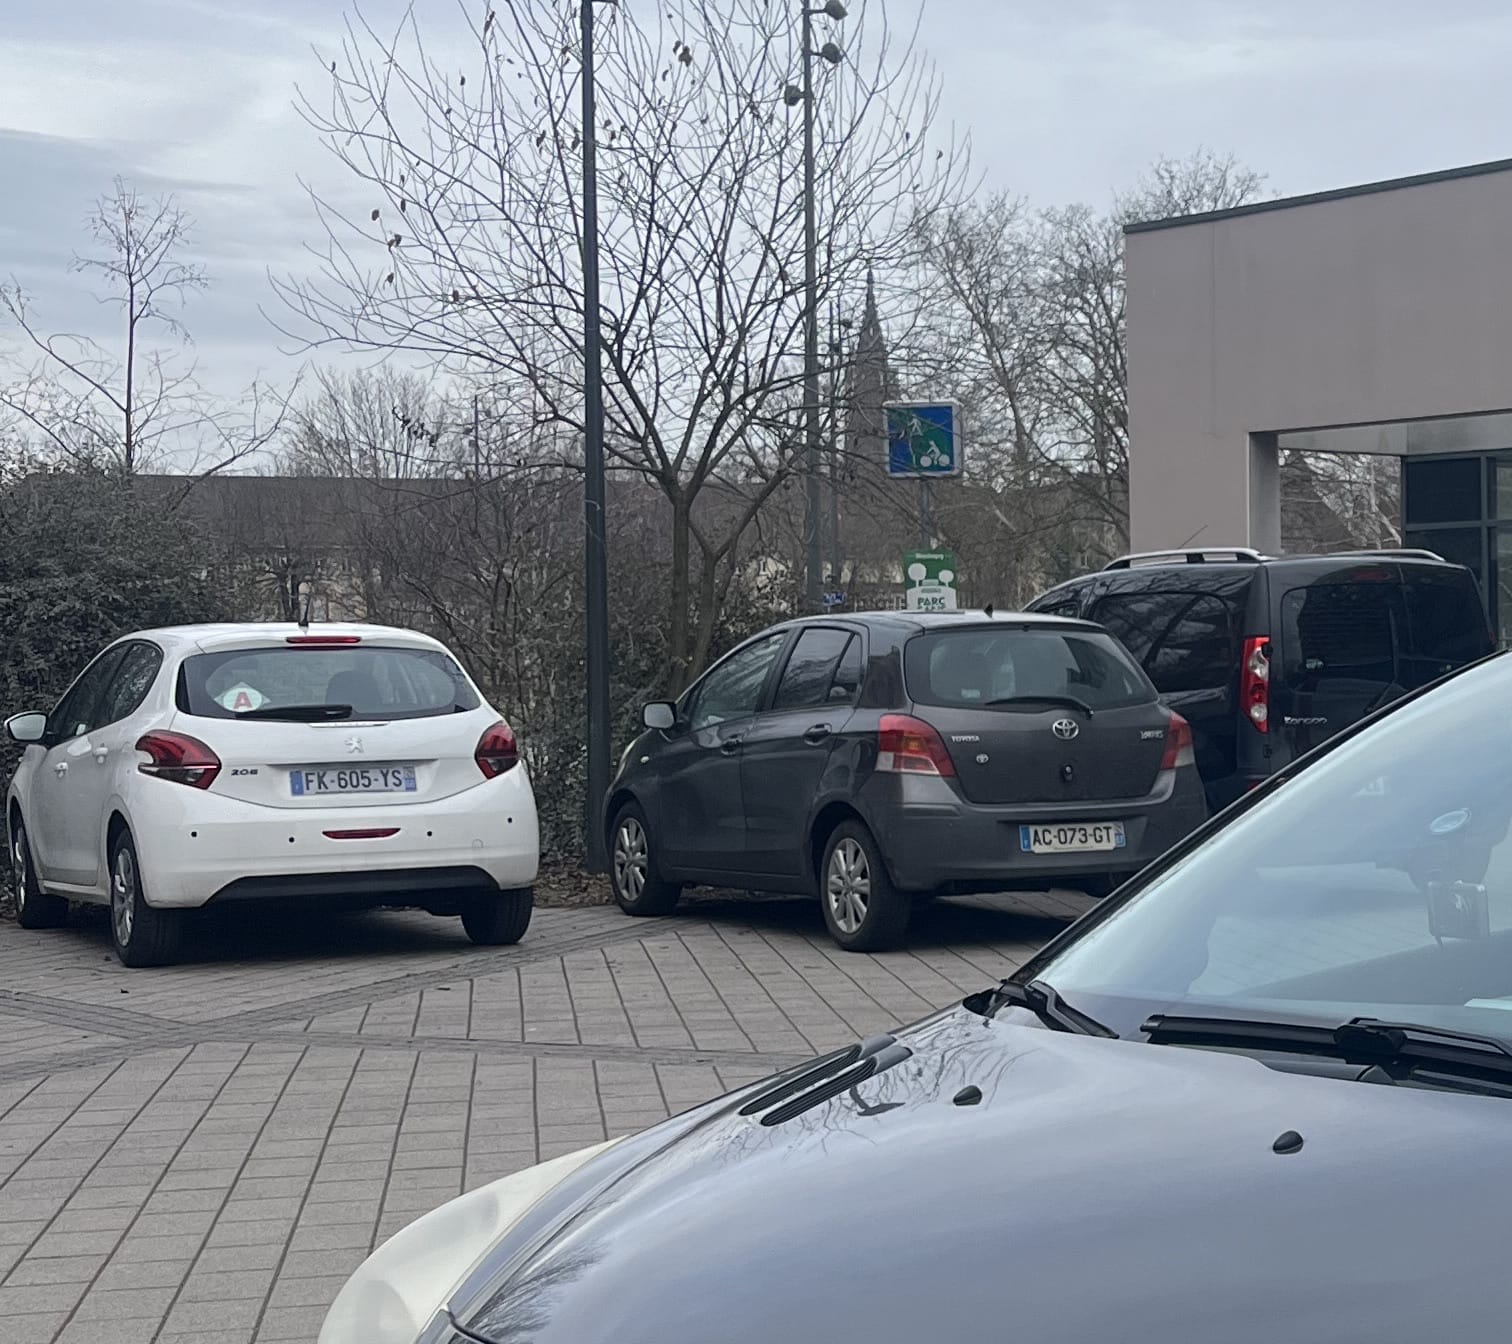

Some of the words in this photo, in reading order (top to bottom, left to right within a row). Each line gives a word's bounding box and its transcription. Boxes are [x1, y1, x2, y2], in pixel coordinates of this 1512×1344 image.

[232, 691, 254, 710] A
[304, 769, 403, 791] FK-605-YS
[1032, 826, 1113, 846] AC-073-GT
